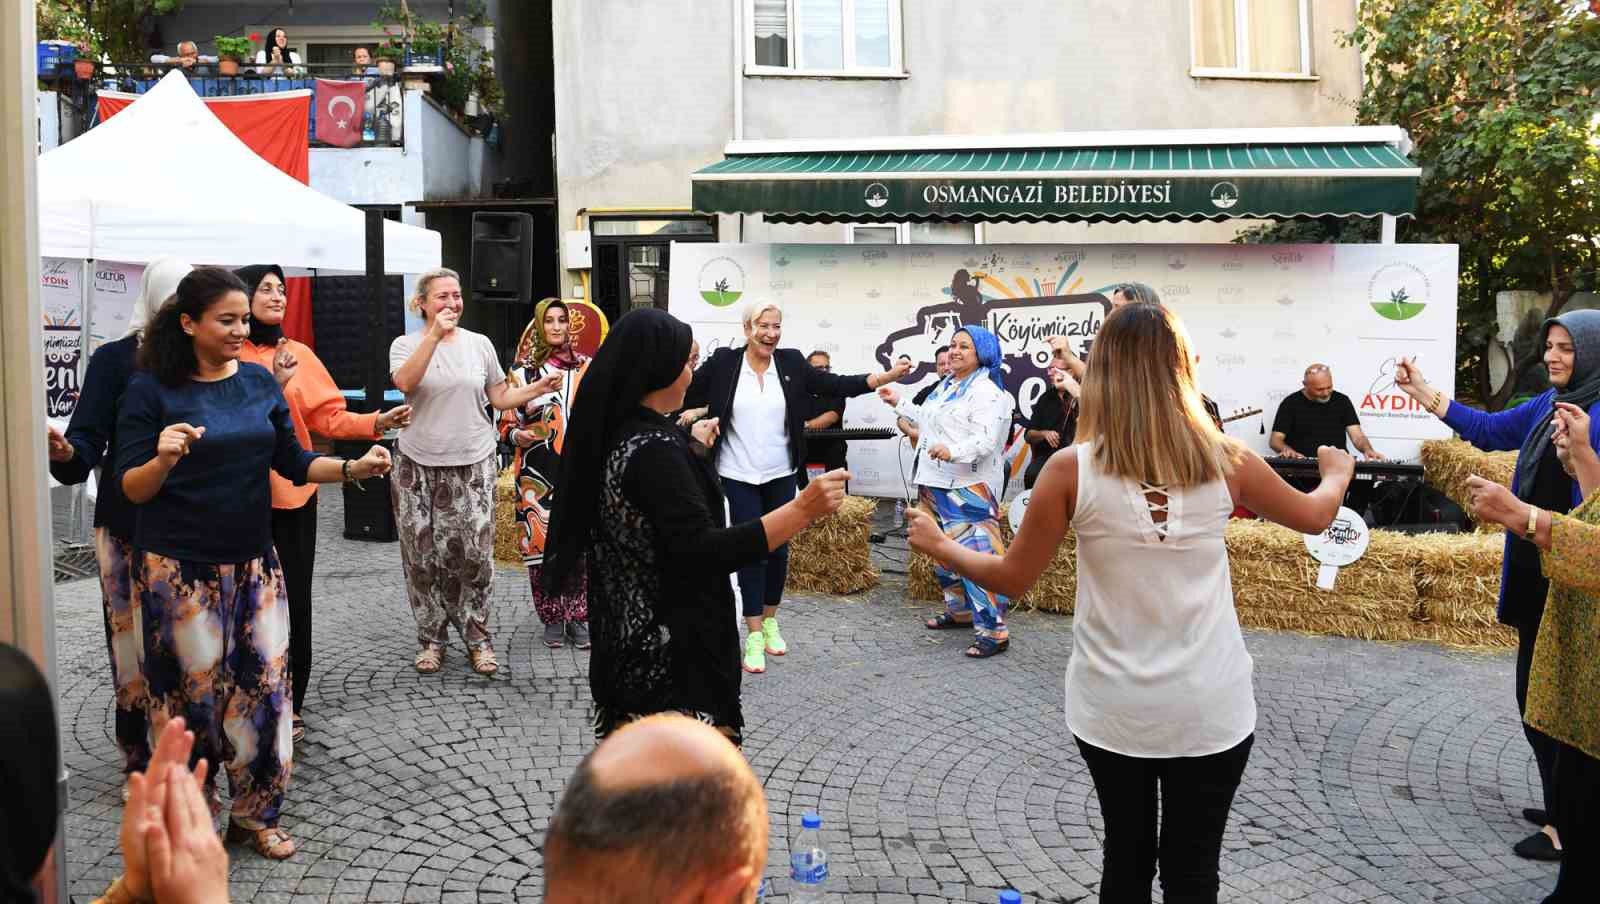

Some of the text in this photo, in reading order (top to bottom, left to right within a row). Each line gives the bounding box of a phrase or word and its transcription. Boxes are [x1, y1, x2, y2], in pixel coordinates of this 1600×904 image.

[923, 180, 1172, 203] OSMANGAZİ BELEDİYESİ
[50, 389, 73, 414] Var
